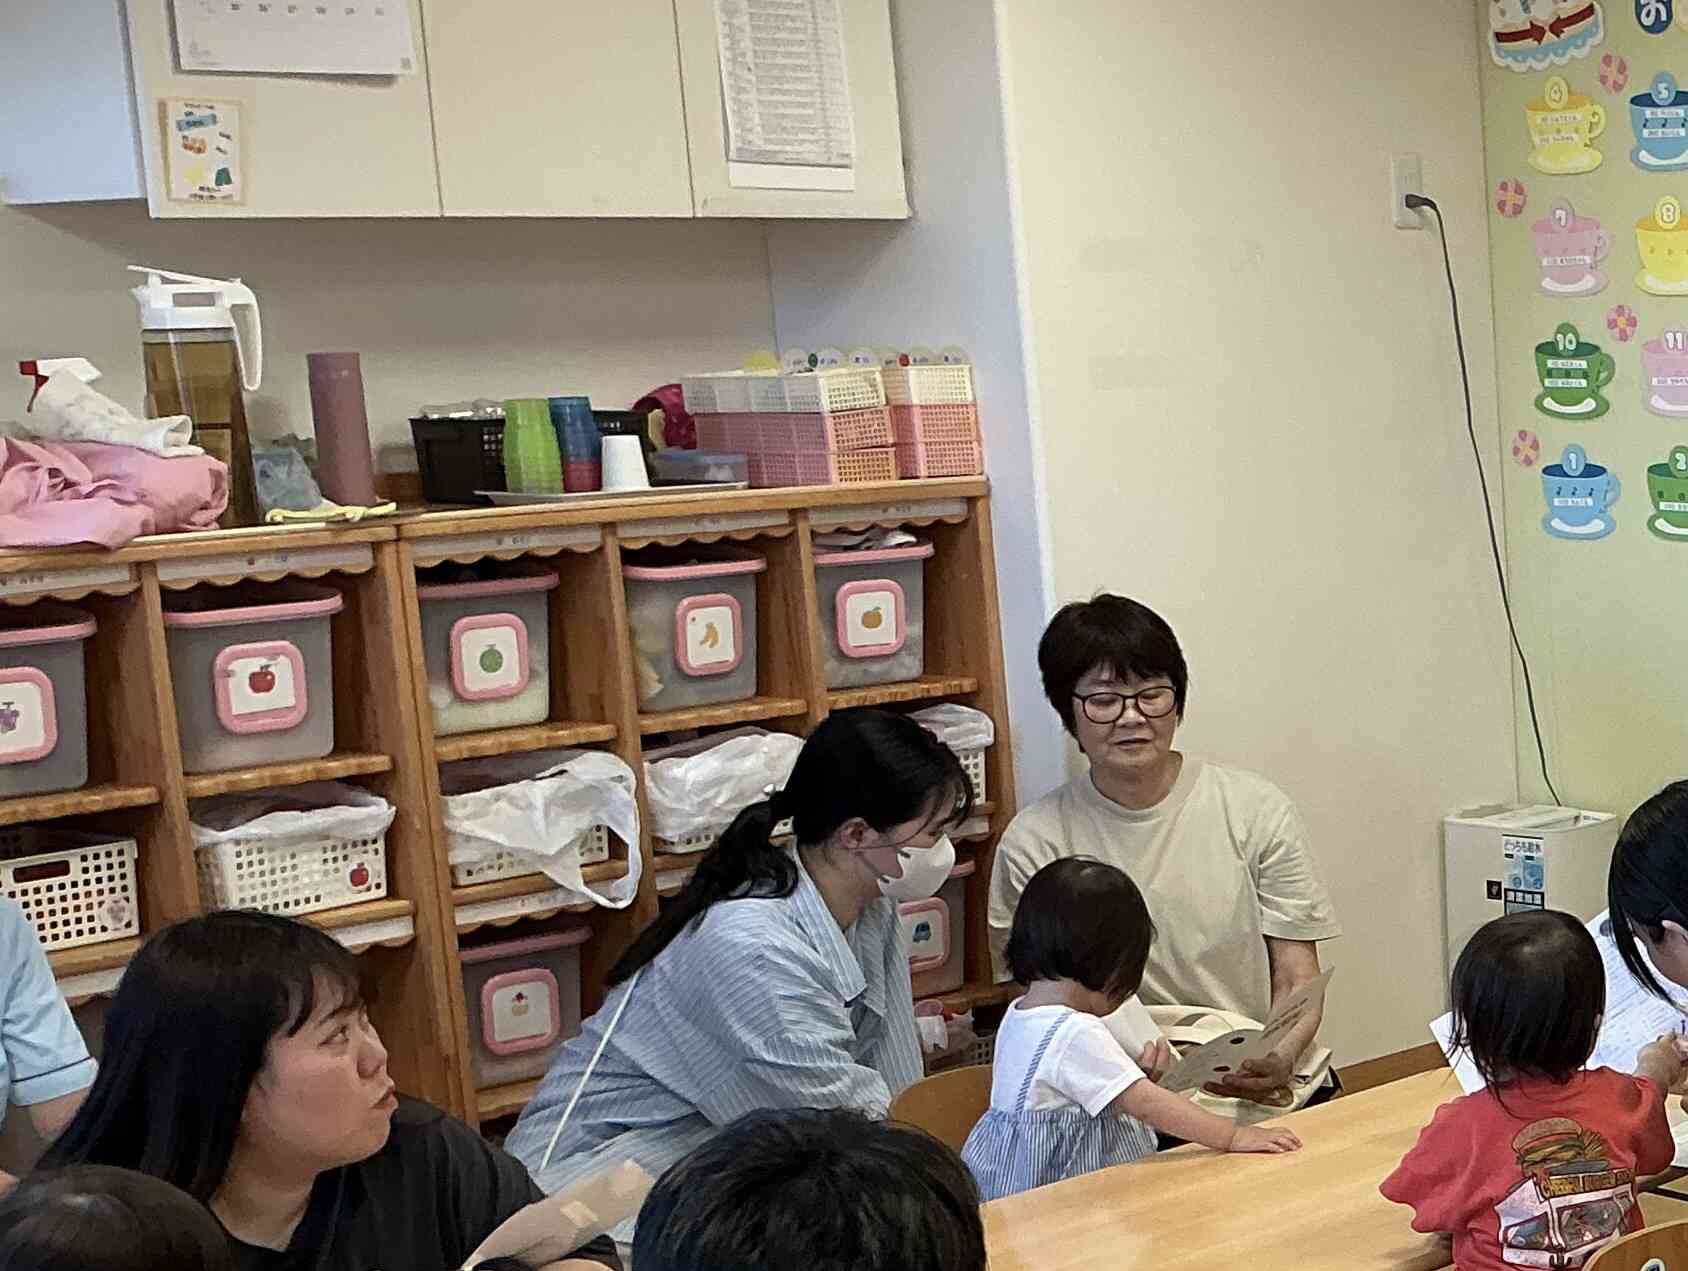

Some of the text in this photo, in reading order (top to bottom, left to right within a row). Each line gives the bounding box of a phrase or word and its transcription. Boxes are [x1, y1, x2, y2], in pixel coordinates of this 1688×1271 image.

[1656, 81, 1671, 98] 5
[1553, 207, 1569, 227] 7
[1662, 201, 1675, 223] 8
[1556, 333, 1577, 351] 10
[1664, 330, 1688, 351] 11
[1673, 452, 1688, 471] 2
